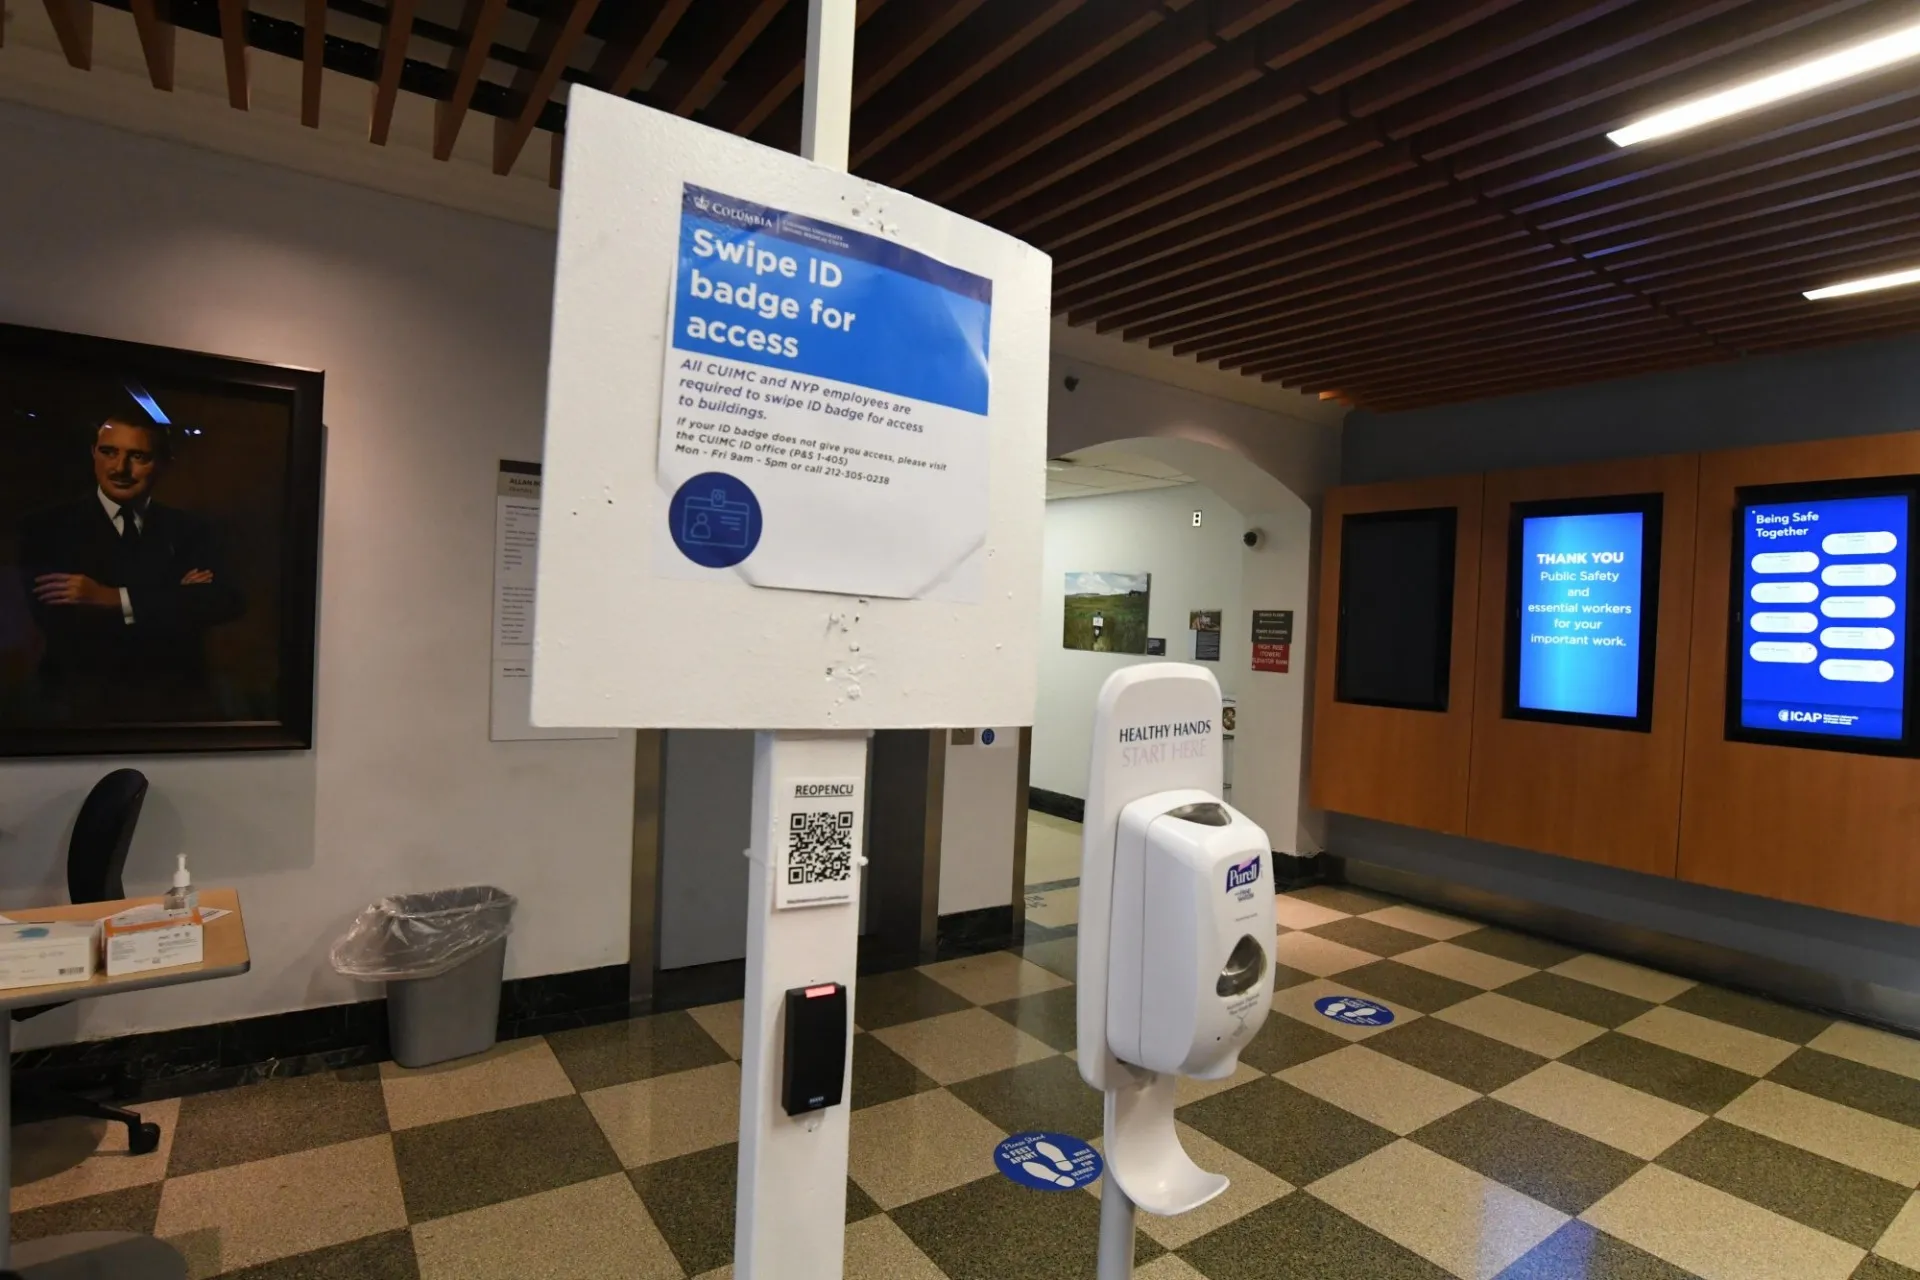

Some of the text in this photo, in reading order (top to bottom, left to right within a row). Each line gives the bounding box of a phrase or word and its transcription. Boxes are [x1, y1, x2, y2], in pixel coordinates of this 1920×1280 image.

[712, 202, 773, 228] COLUMBIA
[692, 228, 843, 288] Swipe ID
[690, 268, 856, 332] badge for
[686, 315, 799, 358] access
[680, 358, 912, 415] All CUIMC and NYP employees are
[677, 394, 768, 420] to buildings.
[679, 378, 925, 434] required to swipe ID badge for access
[675, 431, 849, 467] the CUIMC ID office (P&S 1-405)
[676, 416, 947, 472] If your ID badge does not give you access, please visit
[674, 443, 700, 456] Mon
[710, 448, 727, 460] Fri
[729, 451, 754, 464] 9am
[764, 457, 788, 470] 5pm
[790, 461, 802, 471] or
[804, 463, 823, 474] call
[824, 466, 891, 486] 212-305-0238
[1756, 510, 1820, 525] Being Safe
[1755, 526, 1809, 540] Together
[1536, 551, 1625, 565] THANK YOU
[1540, 570, 1620, 583] Public Safety
[1567, 586, 1590, 598] and
[1528, 602, 1633, 614] essential workers
[1553, 617, 1603, 631] for your
[1530, 633, 1628, 647] important work.
[1790, 710, 1823, 723] ICAP
[1119, 719, 1213, 743] HEALTHY HANDS
[1121, 738, 1207, 768] START HERE
[794, 783, 854, 796] REOPENCU
[1229, 863, 1258, 888] Purell
[1001, 1145, 1032, 1160] 6 FEET
[1009, 1150, 1038, 1165] APART
